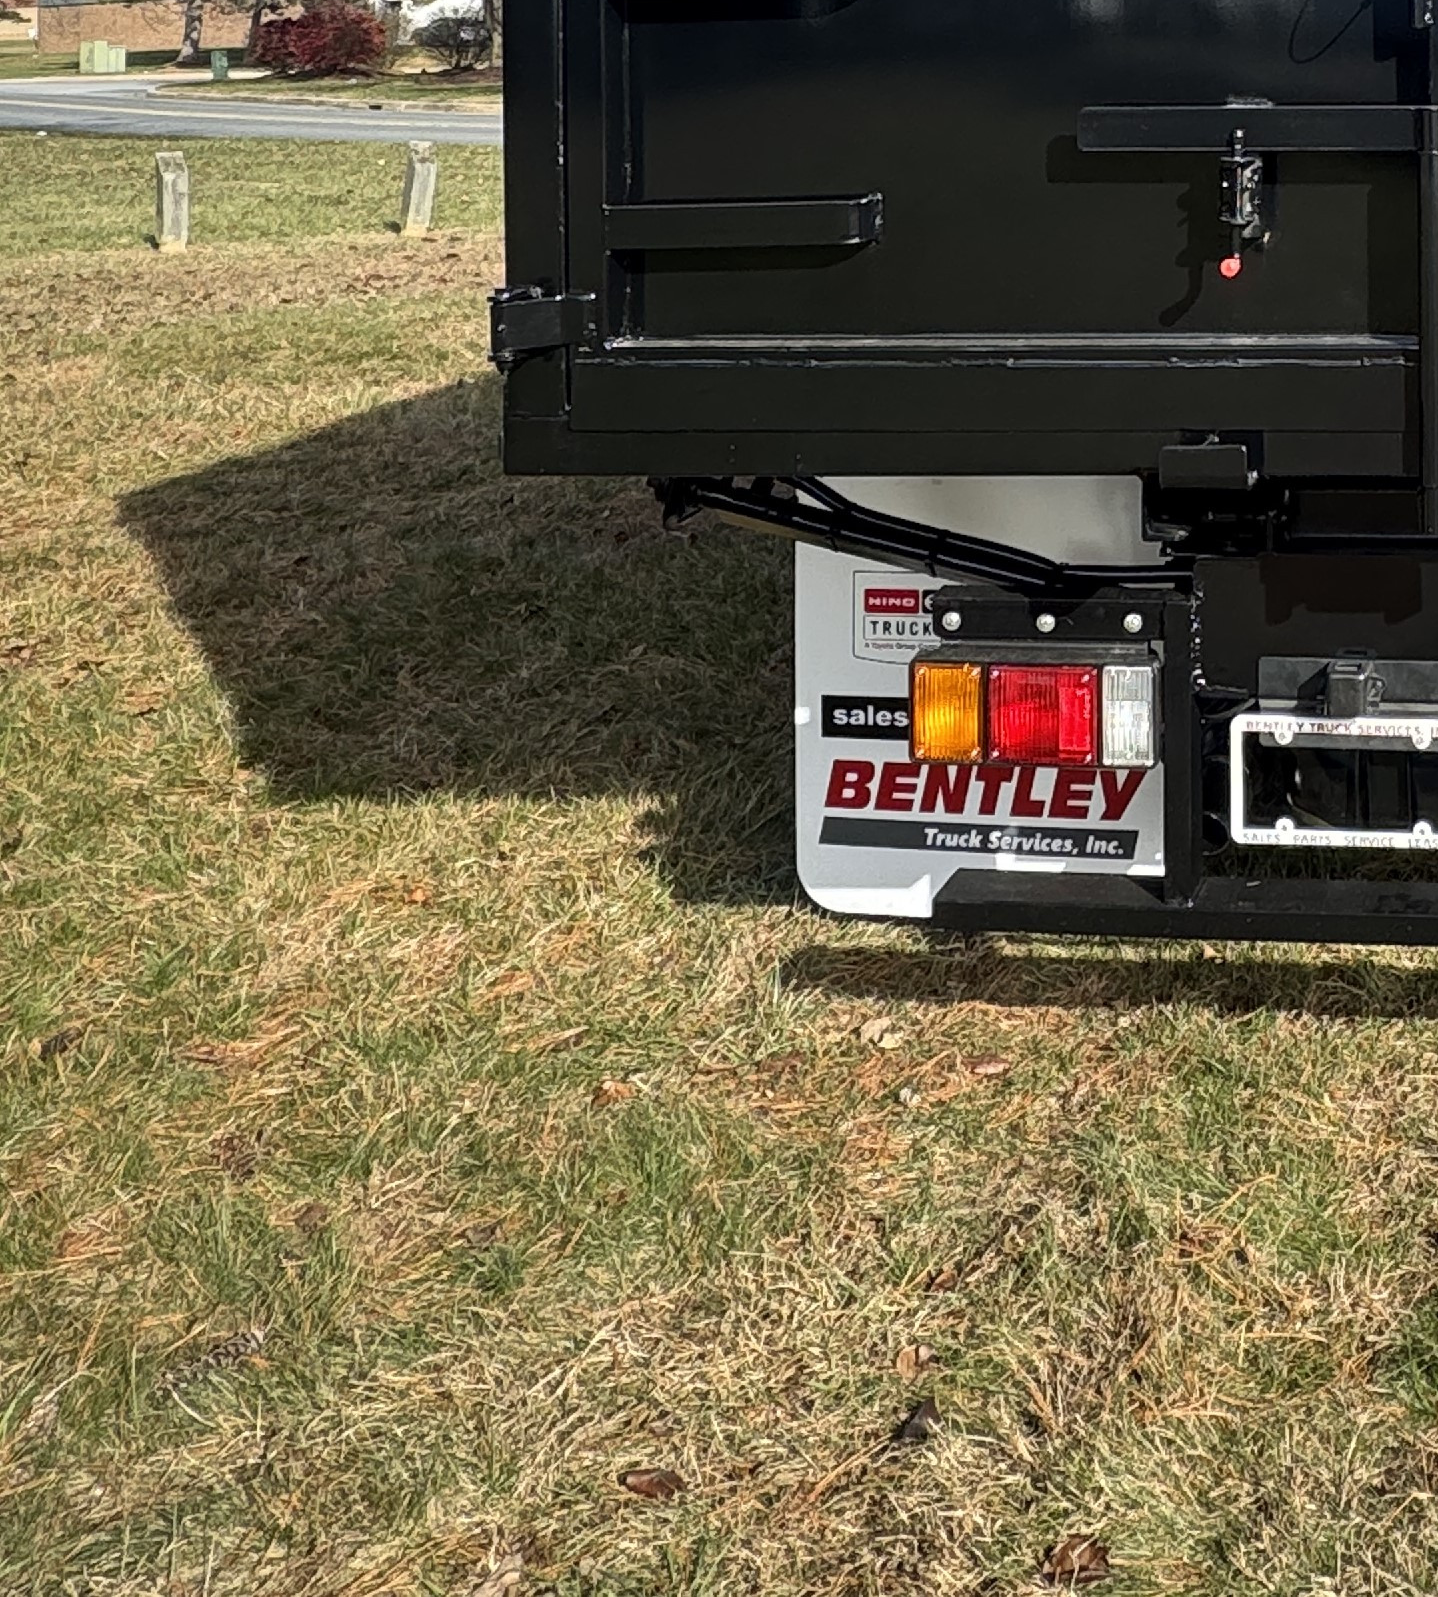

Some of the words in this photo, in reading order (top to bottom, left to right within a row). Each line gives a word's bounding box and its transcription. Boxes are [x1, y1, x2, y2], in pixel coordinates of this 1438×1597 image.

[867, 596, 916, 607] HINO
[869, 620, 932, 636] TRUCK
[832, 704, 910, 728] sales
[825, 759, 1149, 821] BENTLEY
[924, 828, 983, 848] Truck
[987, 830, 1079, 855] Services,
[1086, 835, 1124, 855] Inc.
